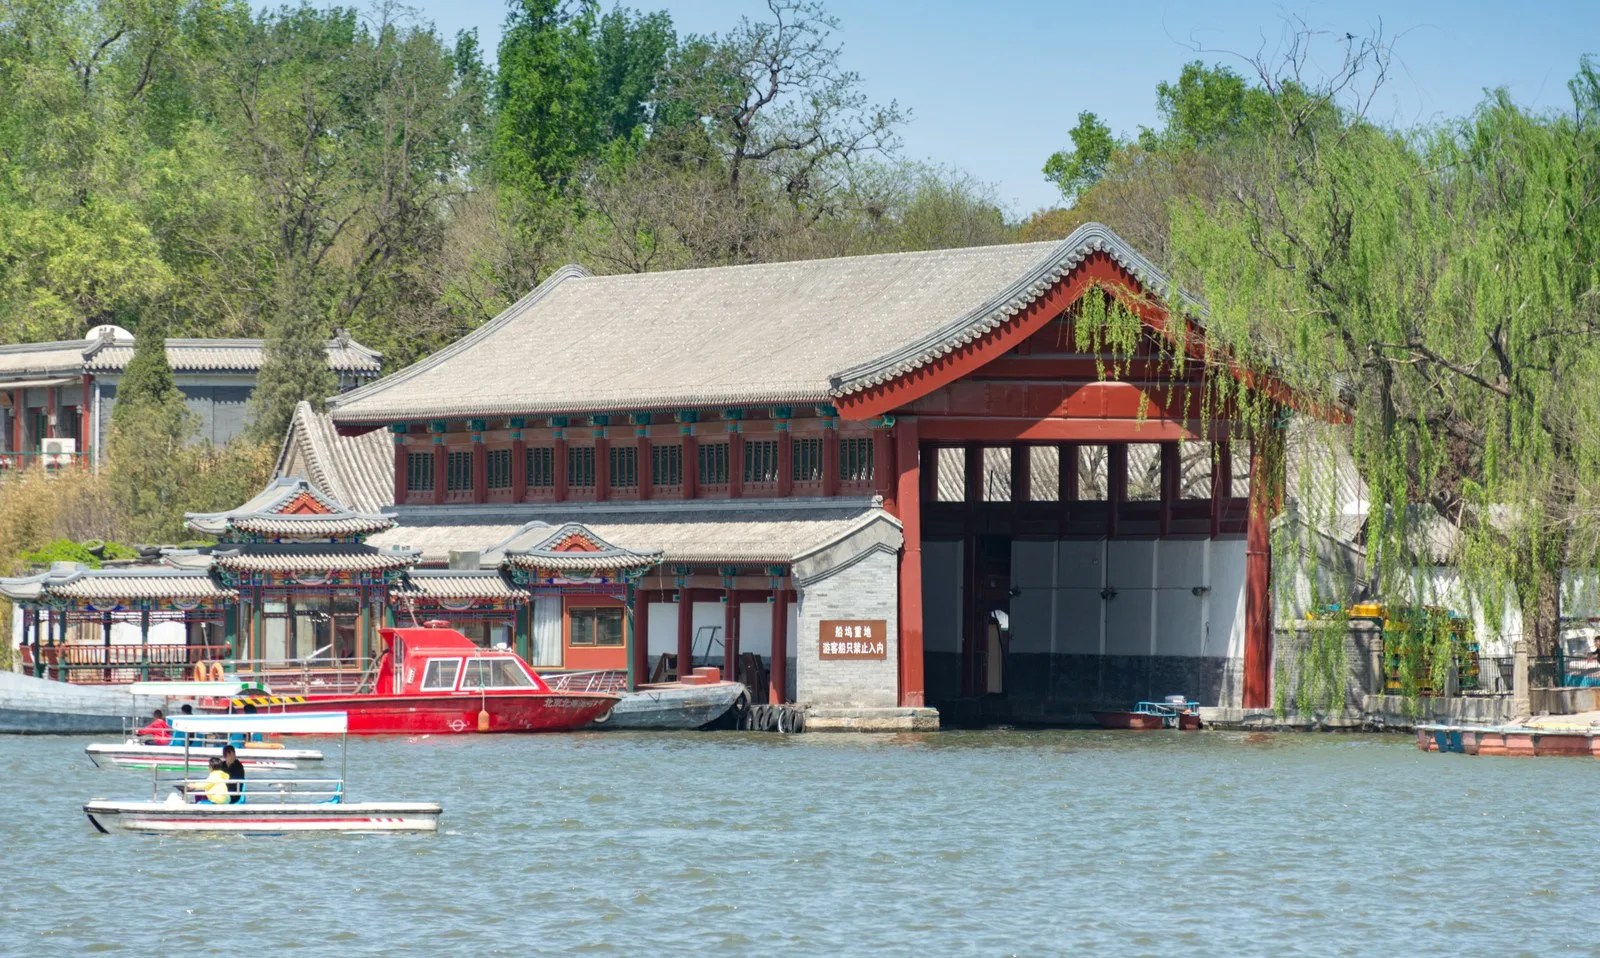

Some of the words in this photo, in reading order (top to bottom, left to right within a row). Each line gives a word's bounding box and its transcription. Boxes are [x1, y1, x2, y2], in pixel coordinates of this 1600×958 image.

[835, 625, 872, 638] 船坞重地
[822, 641, 884, 654] 游客船只禁止入内
